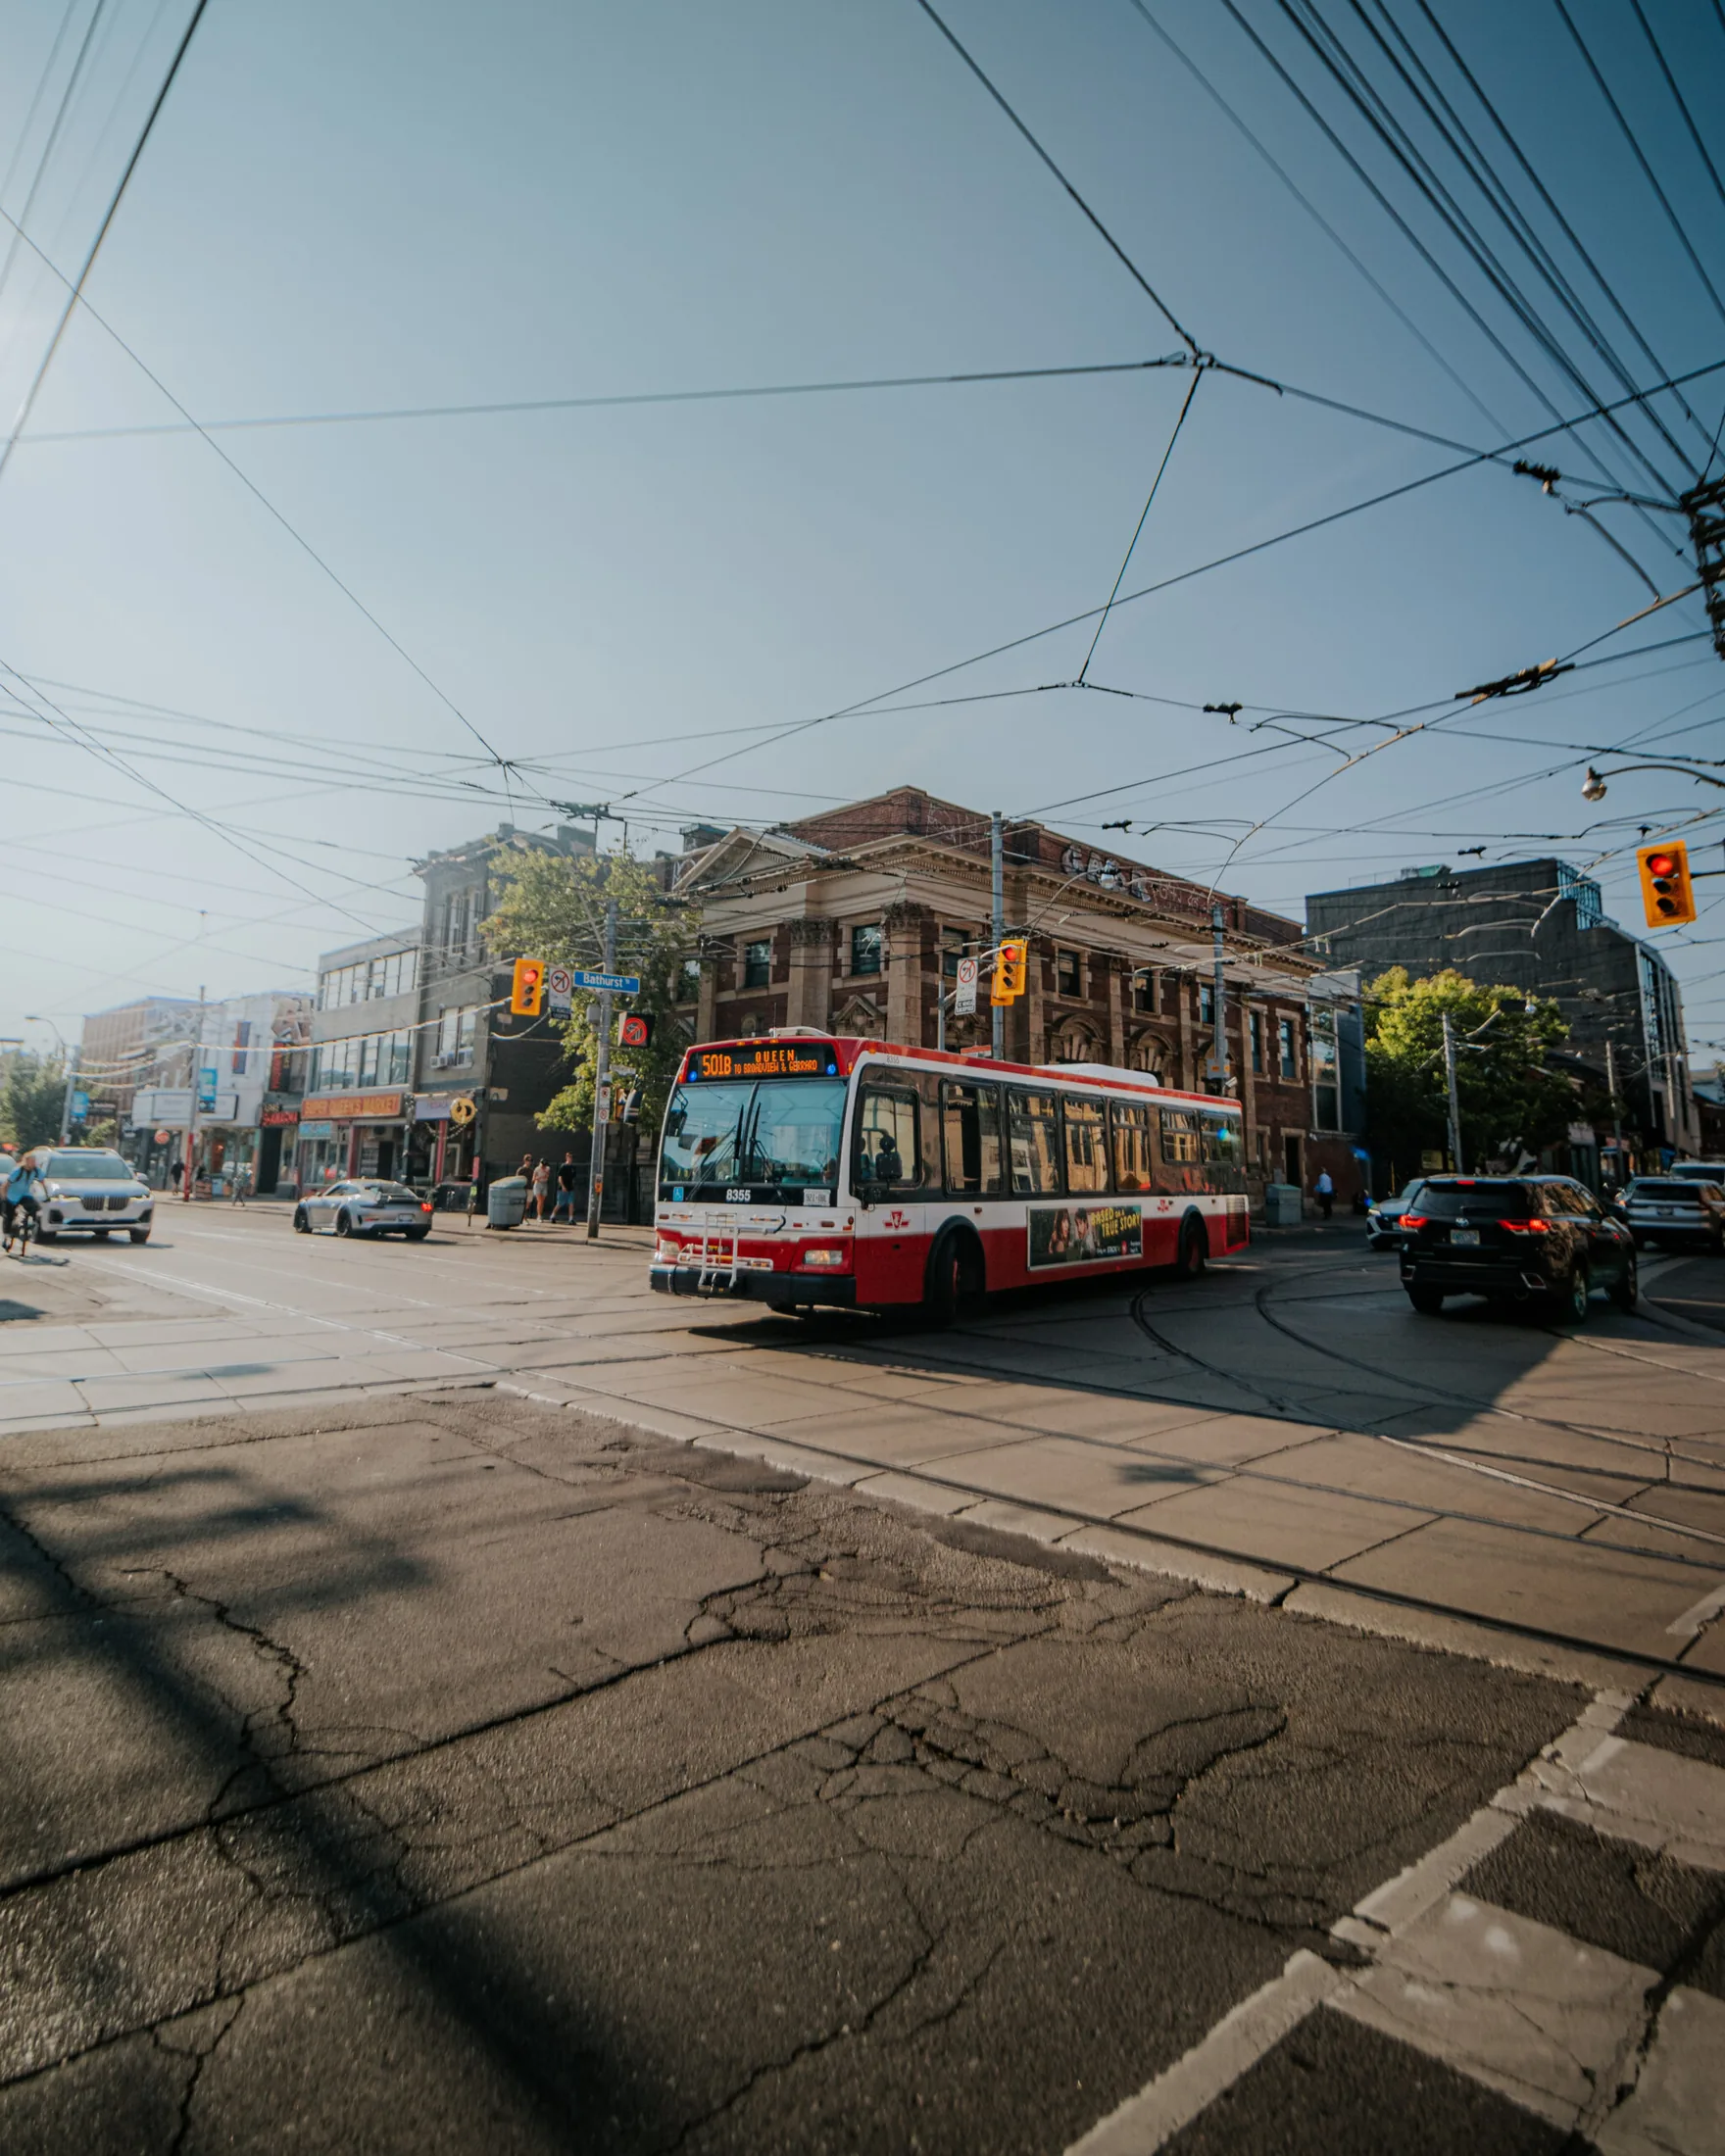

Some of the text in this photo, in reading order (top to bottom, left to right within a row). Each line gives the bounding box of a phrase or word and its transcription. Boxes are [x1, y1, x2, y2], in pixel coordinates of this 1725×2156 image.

[583, 972, 623, 989] Bathurst
[702, 1050, 795, 1076] 501B QUEEN
[734, 1063, 742, 1074] TO
[743, 1060, 779, 1074] BROADVIEW
[789, 1059, 818, 1072] GERRARD
[726, 1188, 752, 1202] 8355
[1091, 1207, 1113, 1226] BASED
[1102, 1212, 1140, 1238] TRUE STORY
